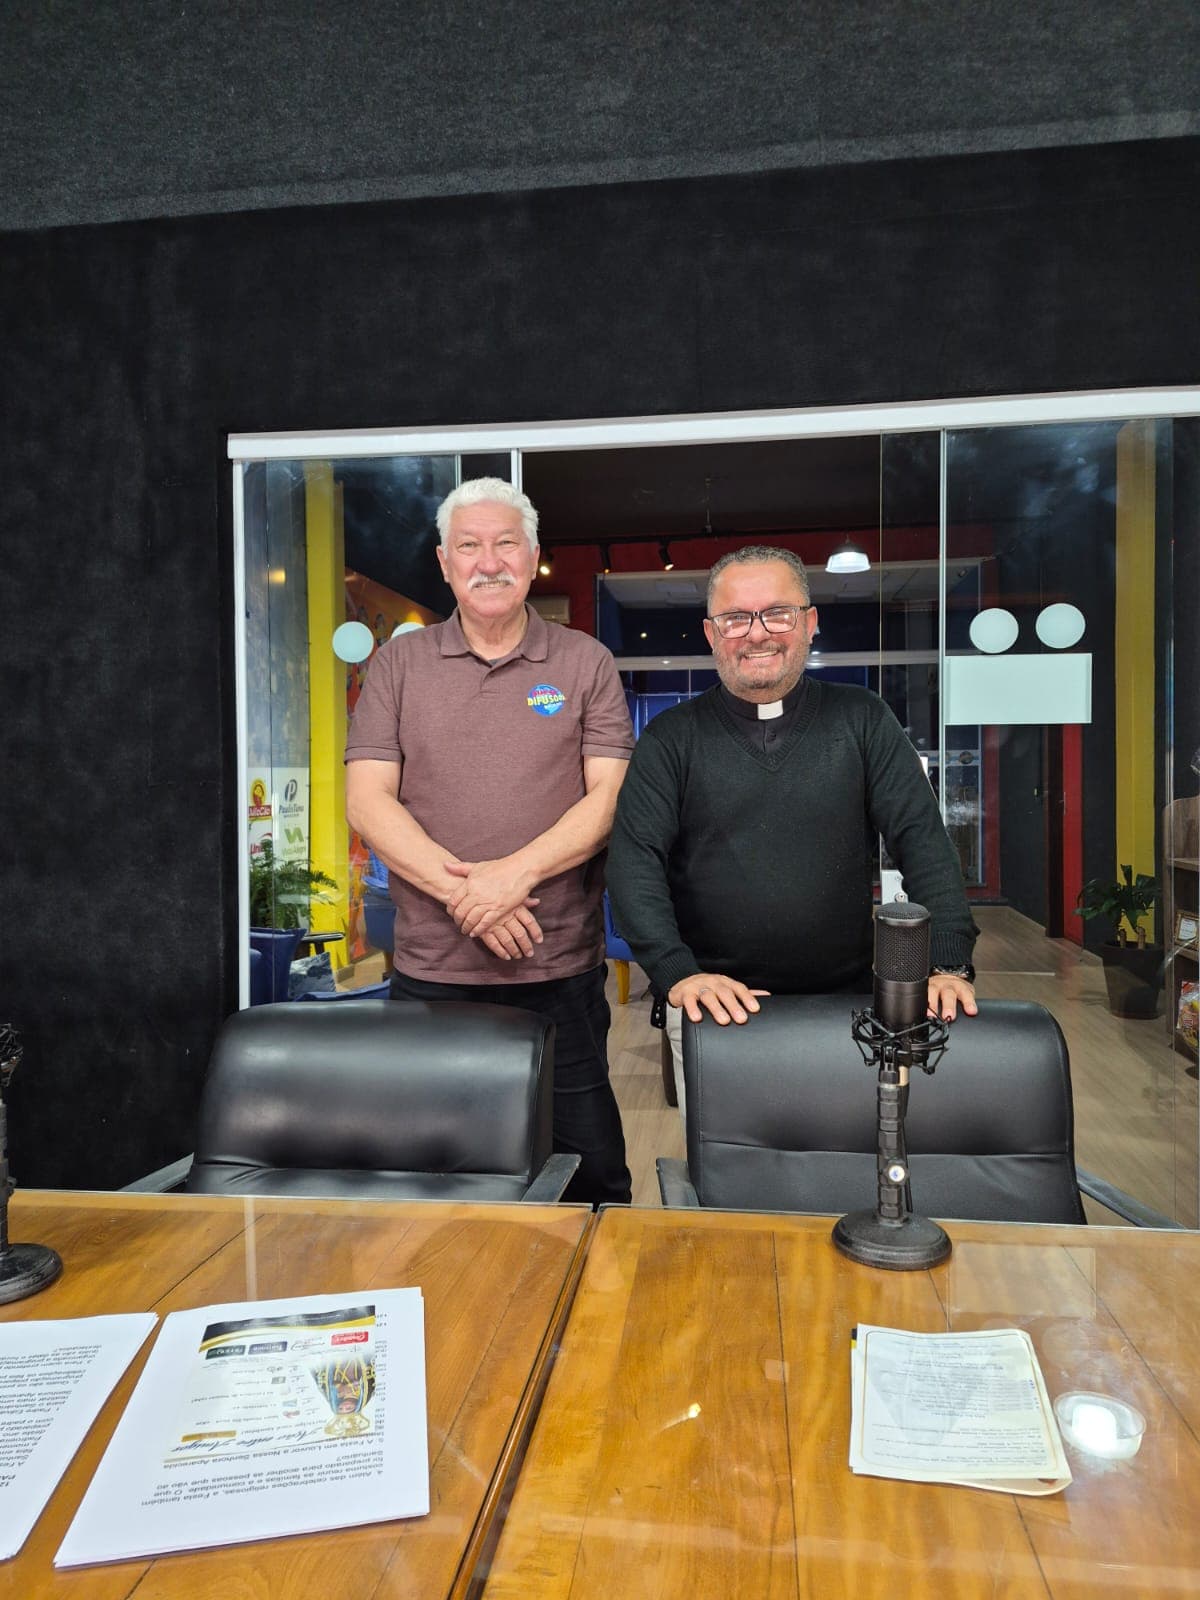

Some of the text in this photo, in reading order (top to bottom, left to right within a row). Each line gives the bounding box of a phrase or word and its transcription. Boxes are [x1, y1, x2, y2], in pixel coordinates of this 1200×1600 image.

[30, 1374, 83, 1383] programação
[6, 1423, 51, 1431] preparado
[340, 1440, 364, 1448] Festa
[253, 1450, 280, 1458] Nossa
[290, 1445, 321, 1454] Louvor
[211, 1454, 250, 1464] Senhora
[324, 1457, 371, 1469] preparado
[163, 1459, 210, 1470] Aparecida
[302, 1463, 323, 1471] para
[345, 1463, 383, 1473] costuma
[265, 1467, 300, 1477] acolher
[190, 1478, 209, 1486] que
[211, 1473, 250, 1484] pessoas
[265, 1474, 300, 1482] famílias
[171, 1481, 188, 1489] vão
[271, 1477, 327, 1490] celebrações
[153, 1489, 172, 1497] que
[183, 1492, 210, 1500] Festa
[141, 1496, 181, 1507] também
